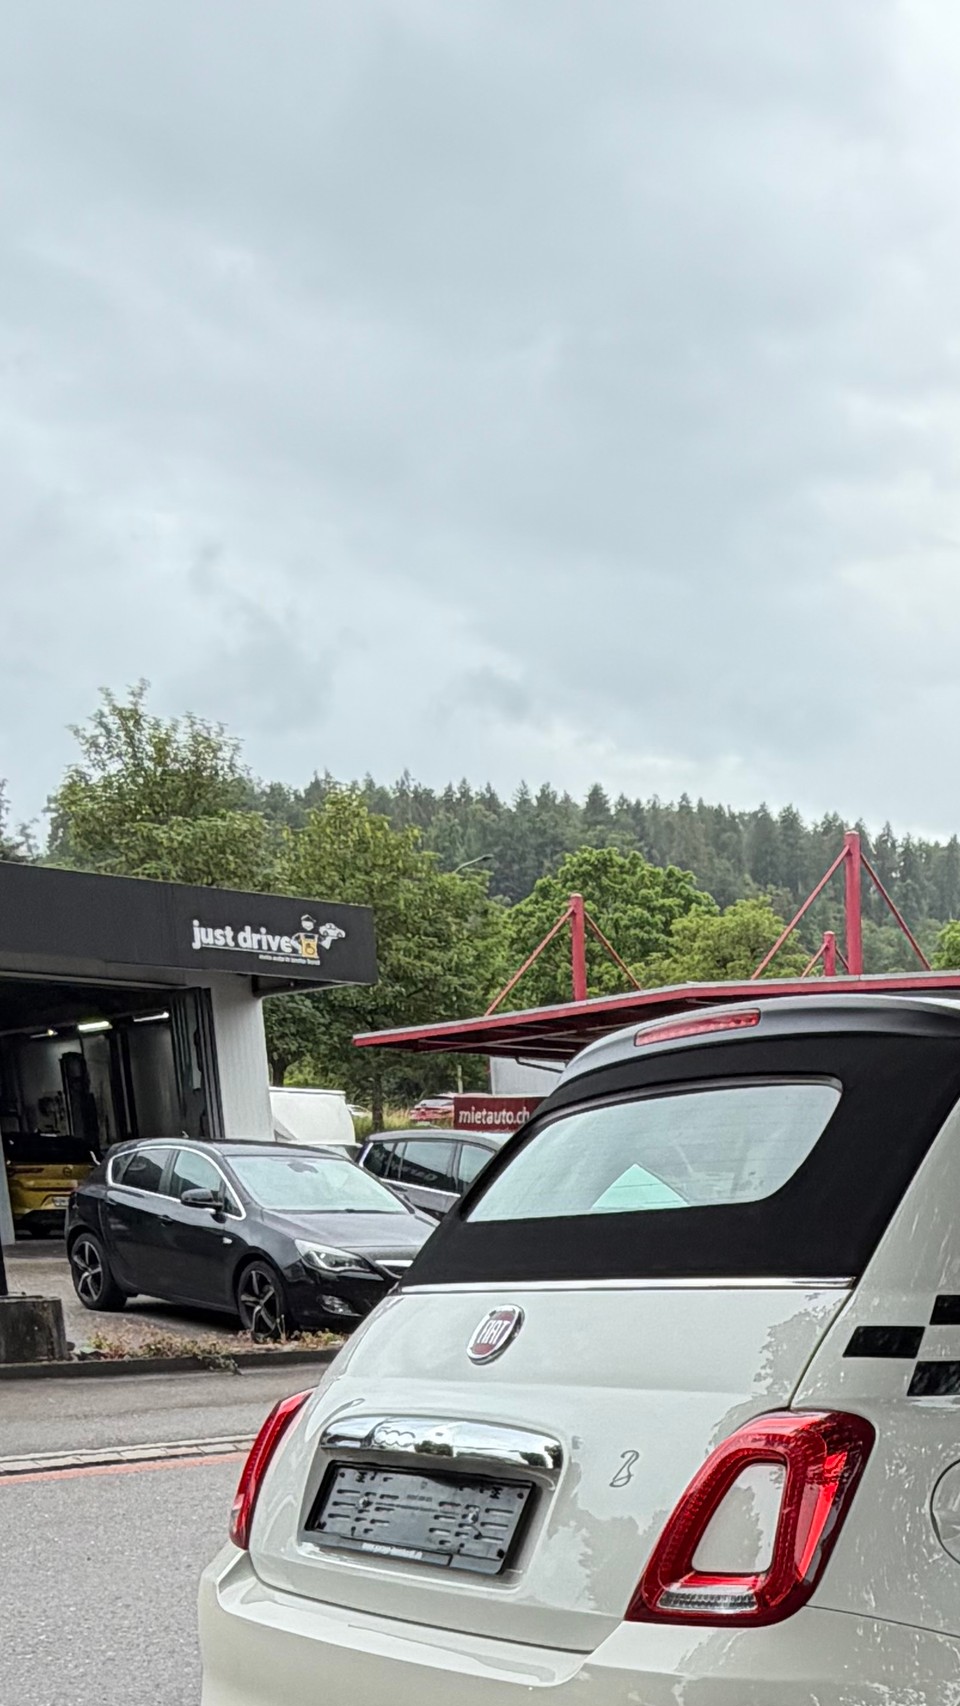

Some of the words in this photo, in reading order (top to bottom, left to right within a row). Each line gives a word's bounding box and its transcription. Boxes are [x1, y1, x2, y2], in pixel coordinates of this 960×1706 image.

[192, 919, 235, 950] just
[237, 925, 293, 953] drive
[458, 1105, 530, 1125] mietauto.ch
[476, 1319, 512, 1345] FIAT
